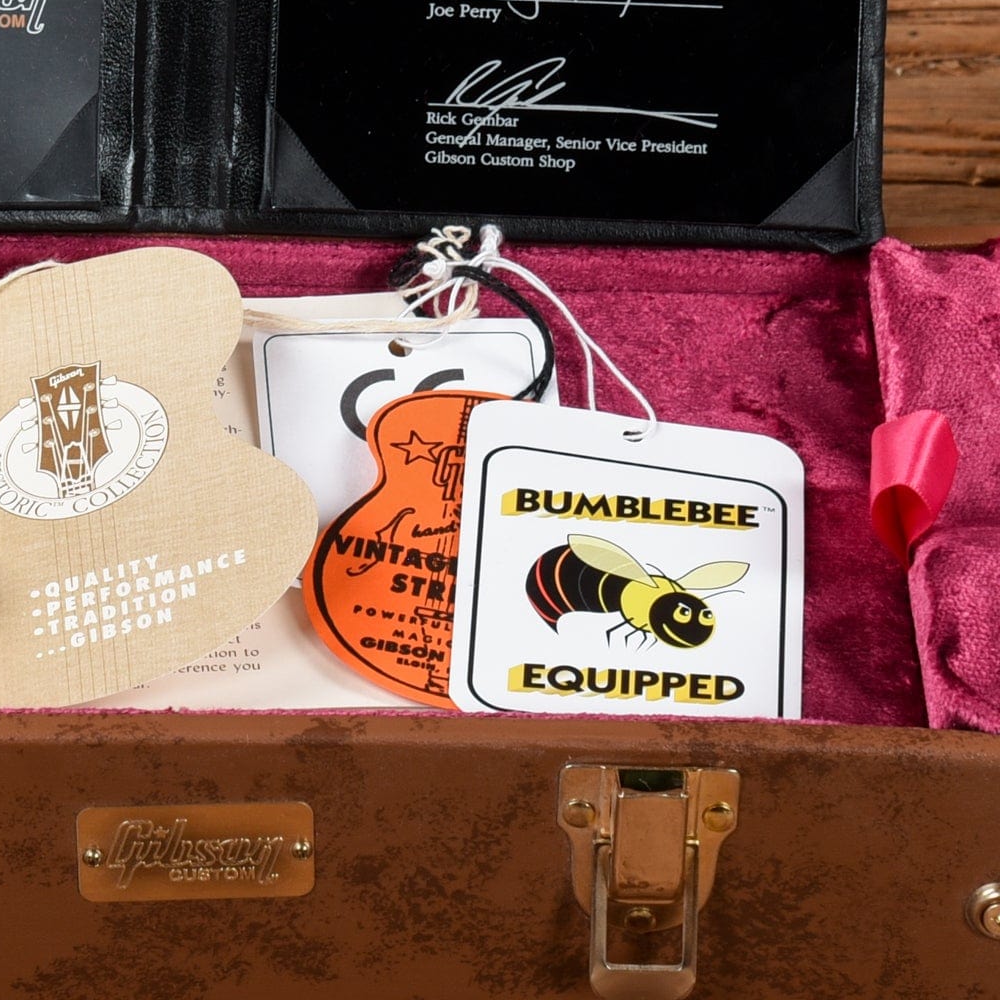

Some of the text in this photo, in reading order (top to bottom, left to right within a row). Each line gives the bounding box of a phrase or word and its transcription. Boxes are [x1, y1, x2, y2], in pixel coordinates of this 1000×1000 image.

[426, 2, 501, 22] Joe Perry
[426, 112, 457, 126] Rick
[425, 131, 707, 154] General Manager, Senior Vice President
[425, 151, 576, 172] Gibson Custom Shop
[49, 368, 84, 389] Gibson
[72, 409, 166, 513] COLLECTION
[360, 637, 445, 662] GIBSON
[233, 663, 261, 673] you
[522, 663, 746, 700] EQUIPPED
[107, 819, 283, 889] Gibson
[169, 866, 256, 881] CUSTOM
